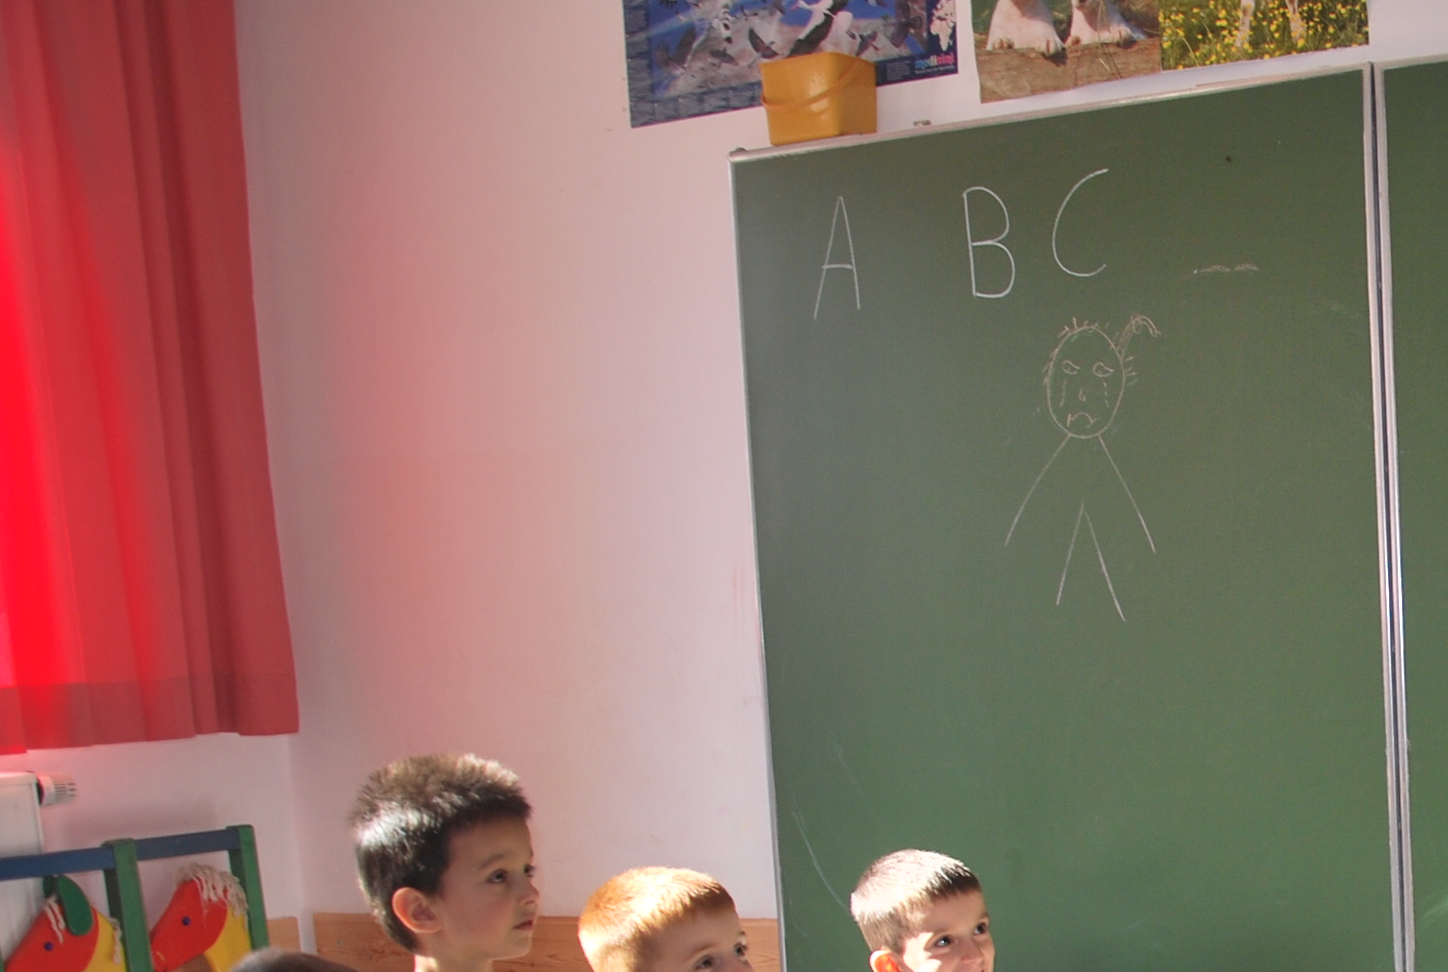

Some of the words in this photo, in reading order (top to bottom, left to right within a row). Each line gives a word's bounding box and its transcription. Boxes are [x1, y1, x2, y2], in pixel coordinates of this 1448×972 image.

[814, 196, 861, 321] A
[963, 186, 1016, 298] B
[1052, 168, 1109, 278] C
